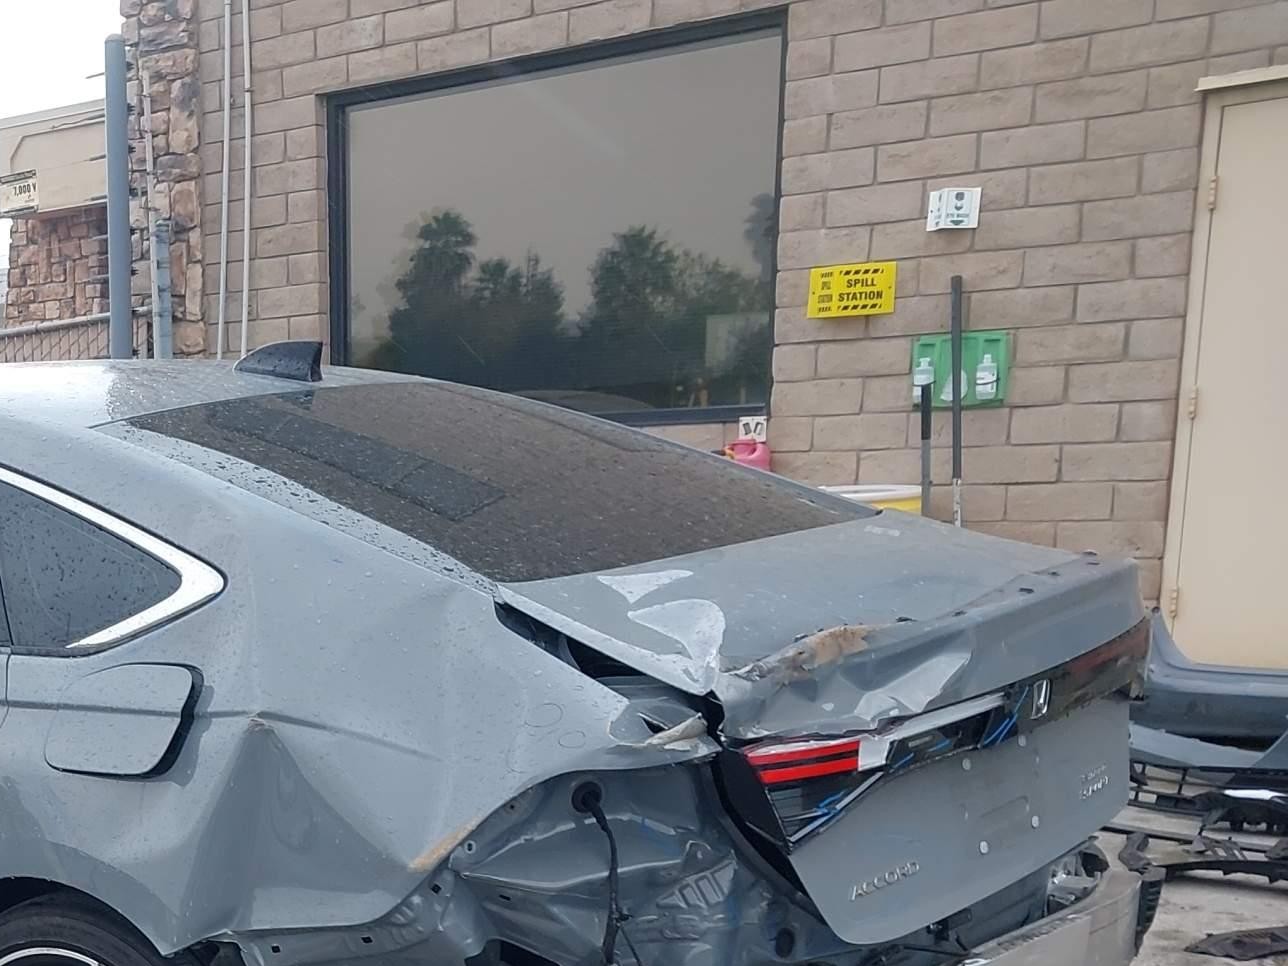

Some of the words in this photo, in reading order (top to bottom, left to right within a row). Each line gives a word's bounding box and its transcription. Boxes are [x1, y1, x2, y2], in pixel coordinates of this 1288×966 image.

[846, 277, 877, 289] SPILL
[838, 290, 884, 303] STATION
[848, 861, 920, 900] ACCORD
